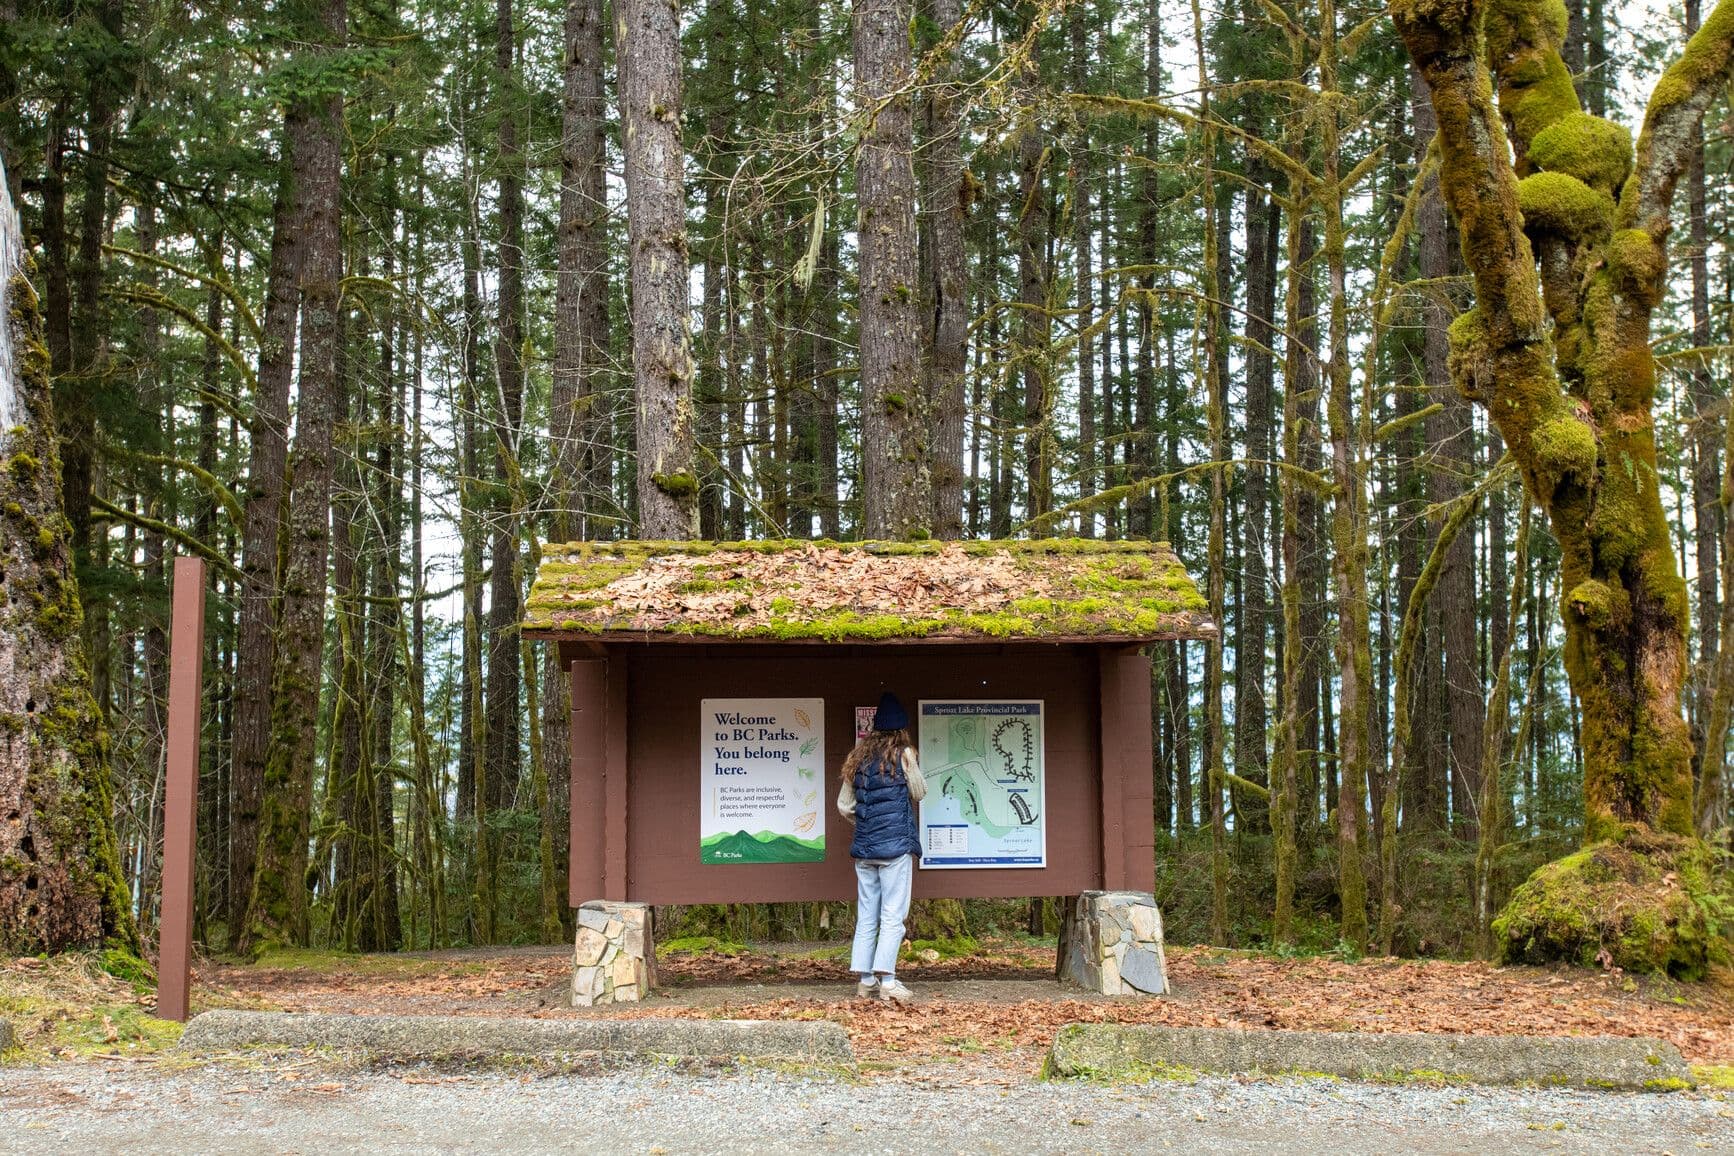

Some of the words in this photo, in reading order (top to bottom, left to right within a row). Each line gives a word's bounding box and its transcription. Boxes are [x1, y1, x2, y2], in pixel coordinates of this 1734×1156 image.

[958, 706, 974, 714] Lake
[976, 706, 1010, 714] Provincial
[1011, 706, 1027, 714] Park
[714, 712, 776, 725] Welcome
[715, 731, 728, 741] to
[733, 729, 755, 741] BC
[759, 729, 799, 741] Parks.
[714, 746, 740, 759] You
[744, 746, 790, 763] belong
[714, 763, 748, 776] here.
[755, 786, 783, 794] inclusive,
[720, 794, 743, 802] diverse,
[755, 794, 785, 803] respectful
[720, 803, 739, 811] places
[758, 803, 786, 811] everyone
